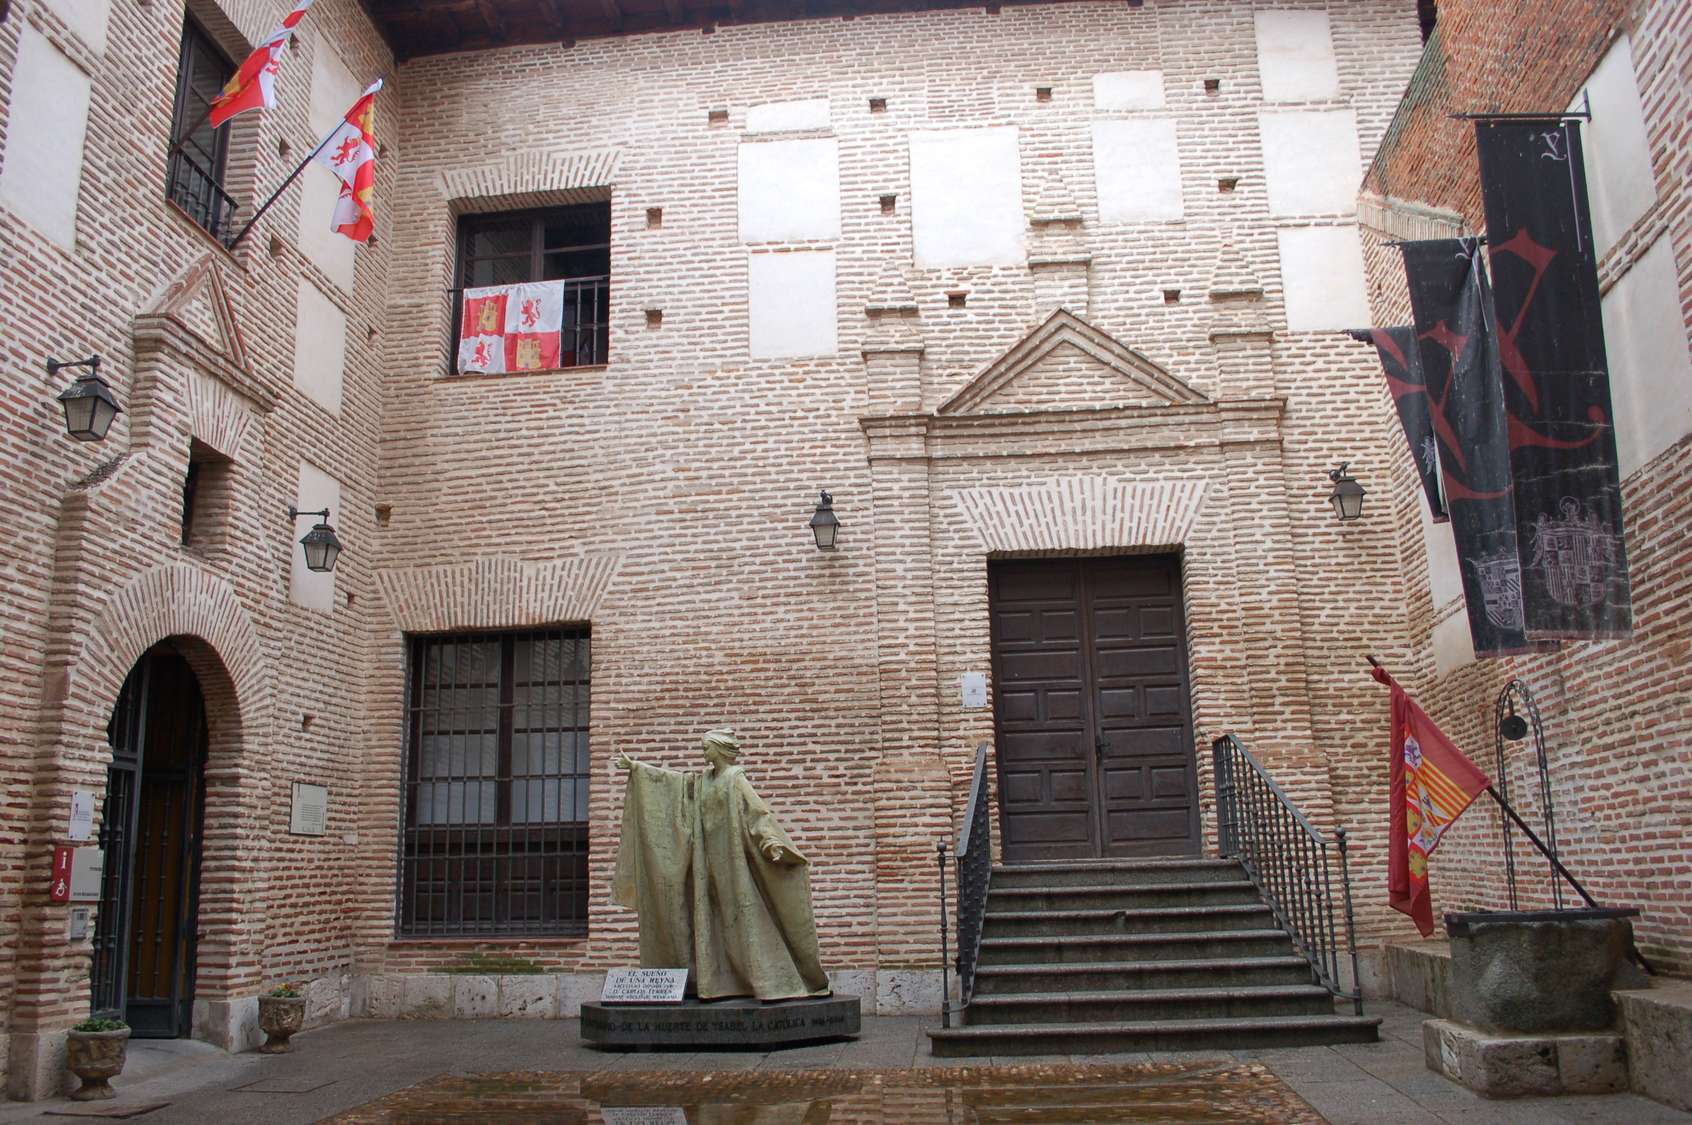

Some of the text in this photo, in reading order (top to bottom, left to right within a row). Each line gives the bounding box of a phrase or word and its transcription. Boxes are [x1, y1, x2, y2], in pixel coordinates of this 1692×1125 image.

[639, 1022, 650, 1032] LA
[655, 1022, 692, 1032] MUERTE
[696, 1022, 709, 1032] DE
